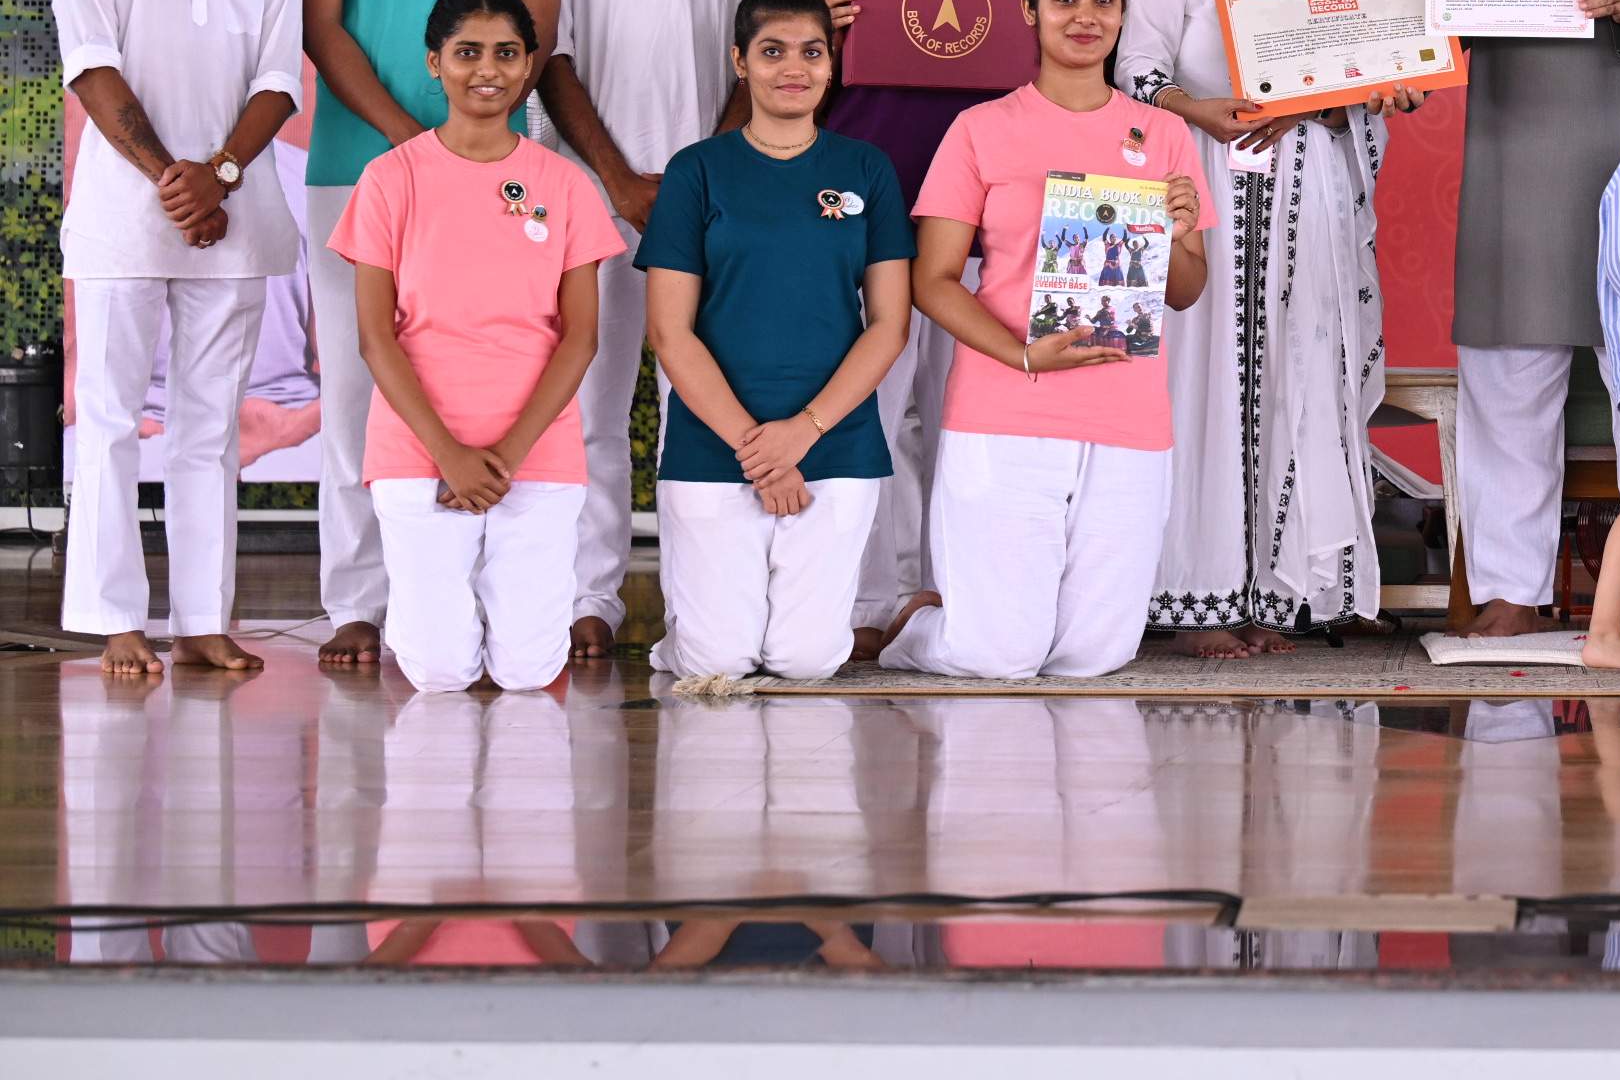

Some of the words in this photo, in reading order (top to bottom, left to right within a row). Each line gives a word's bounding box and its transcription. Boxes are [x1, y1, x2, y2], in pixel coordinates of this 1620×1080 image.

[906, 10, 928, 42] BOOK
[926, 38, 943, 52] OF
[945, 16, 987, 54] RECORDS
[1048, 182, 1095, 201] INDIA
[1100, 188, 1142, 206] BOOK
